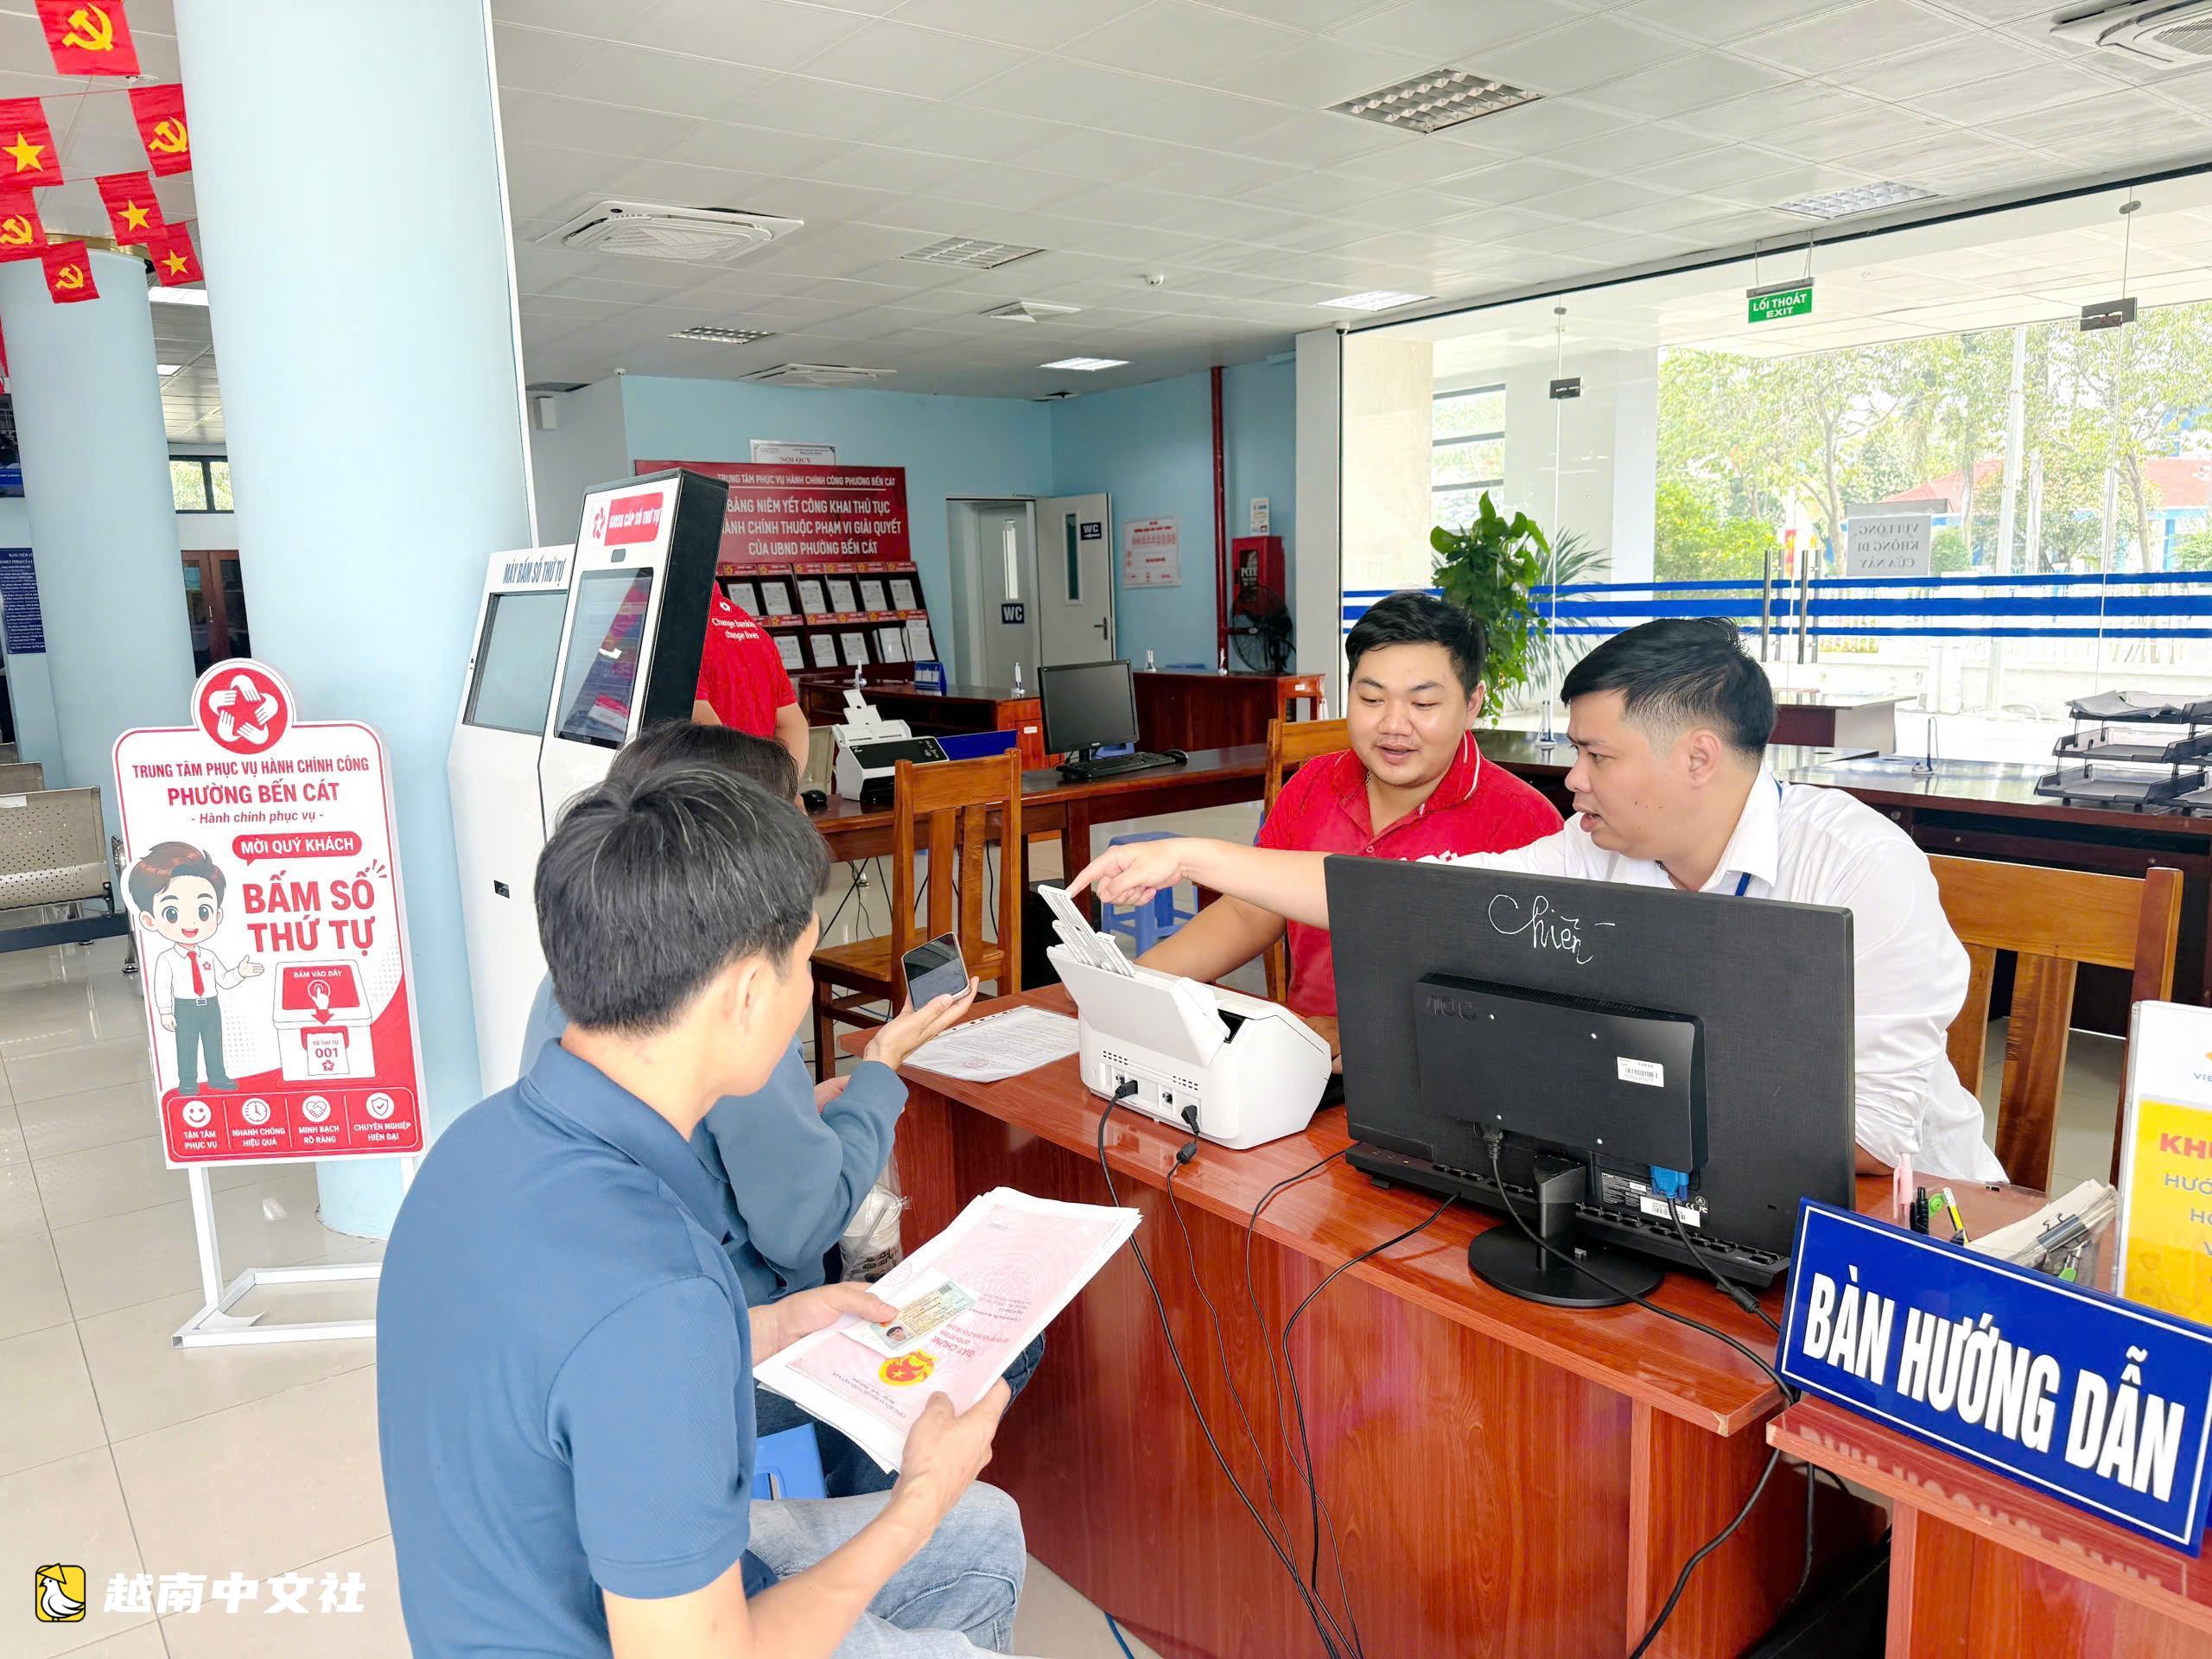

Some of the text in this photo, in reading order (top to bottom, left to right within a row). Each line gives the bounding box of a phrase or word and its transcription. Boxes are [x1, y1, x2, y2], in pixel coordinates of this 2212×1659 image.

[1753, 292, 1807, 311] LỐI THOÁT
[1766, 307, 1794, 318] EXIT
[741, 473, 754, 484] TÂM
[756, 475, 775, 486] PHỤC
[776, 475, 785, 486] VỤ
[785, 474, 804, 485] HÀNH
[805, 475, 825, 485] CHÍNH
[826, 475, 843, 485] CÔNG
[845, 476, 870, 486] PHƯỜNG
[871, 475, 884, 486] BẾN
[885, 477, 896, 486] CÁT
[727, 495, 891, 517] BẢNG NIÊM YẾT CÔNG KHAI THỦ TỤC
[747, 518, 778, 534] CHÍNH
[780, 518, 813, 537] THUỘC
[815, 520, 842, 537] PHẠM
[842, 521, 852, 534] VI
[854, 518, 872, 534] GIẢI
[874, 517, 901, 537] QUYẾT
[1084, 524, 1099, 533] WC
[748, 537, 878, 556] CỦA UBND PHƯỜNG BẾN CÁT
[503, 558, 518, 583] MÁY
[542, 556, 557, 582] THỨ
[555, 557, 567, 587] TỰ
[712, 618, 735, 628] Change
[1003, 607, 1022, 620] WC
[132, 754, 369, 779] TRUNG TÂM PHỤC VỤ HÀNH CHÍNH CÔNG
[168, 779, 340, 806] PHƯỜNG BẾN CÁT
[200, 810, 315, 824] Hành chính phục vụ
[241, 836, 353, 855] MỜI QUÝ KHÁCH
[242, 867, 375, 913] BẤM SỐ
[247, 914, 375, 957] THỨ TỰ
[315, 1047, 339, 1058] 001
[232, 1128, 258, 1137] NHANH
[320, 1125, 340, 1134] BẠCH
[353, 1121, 411, 1131] CHUYÊN NGHIỆP
[1802, 1264, 1896, 1386] BÀN
[1897, 1313, 2062, 1454] HƯỚNG
[2064, 1344, 2185, 1503] DẪN
